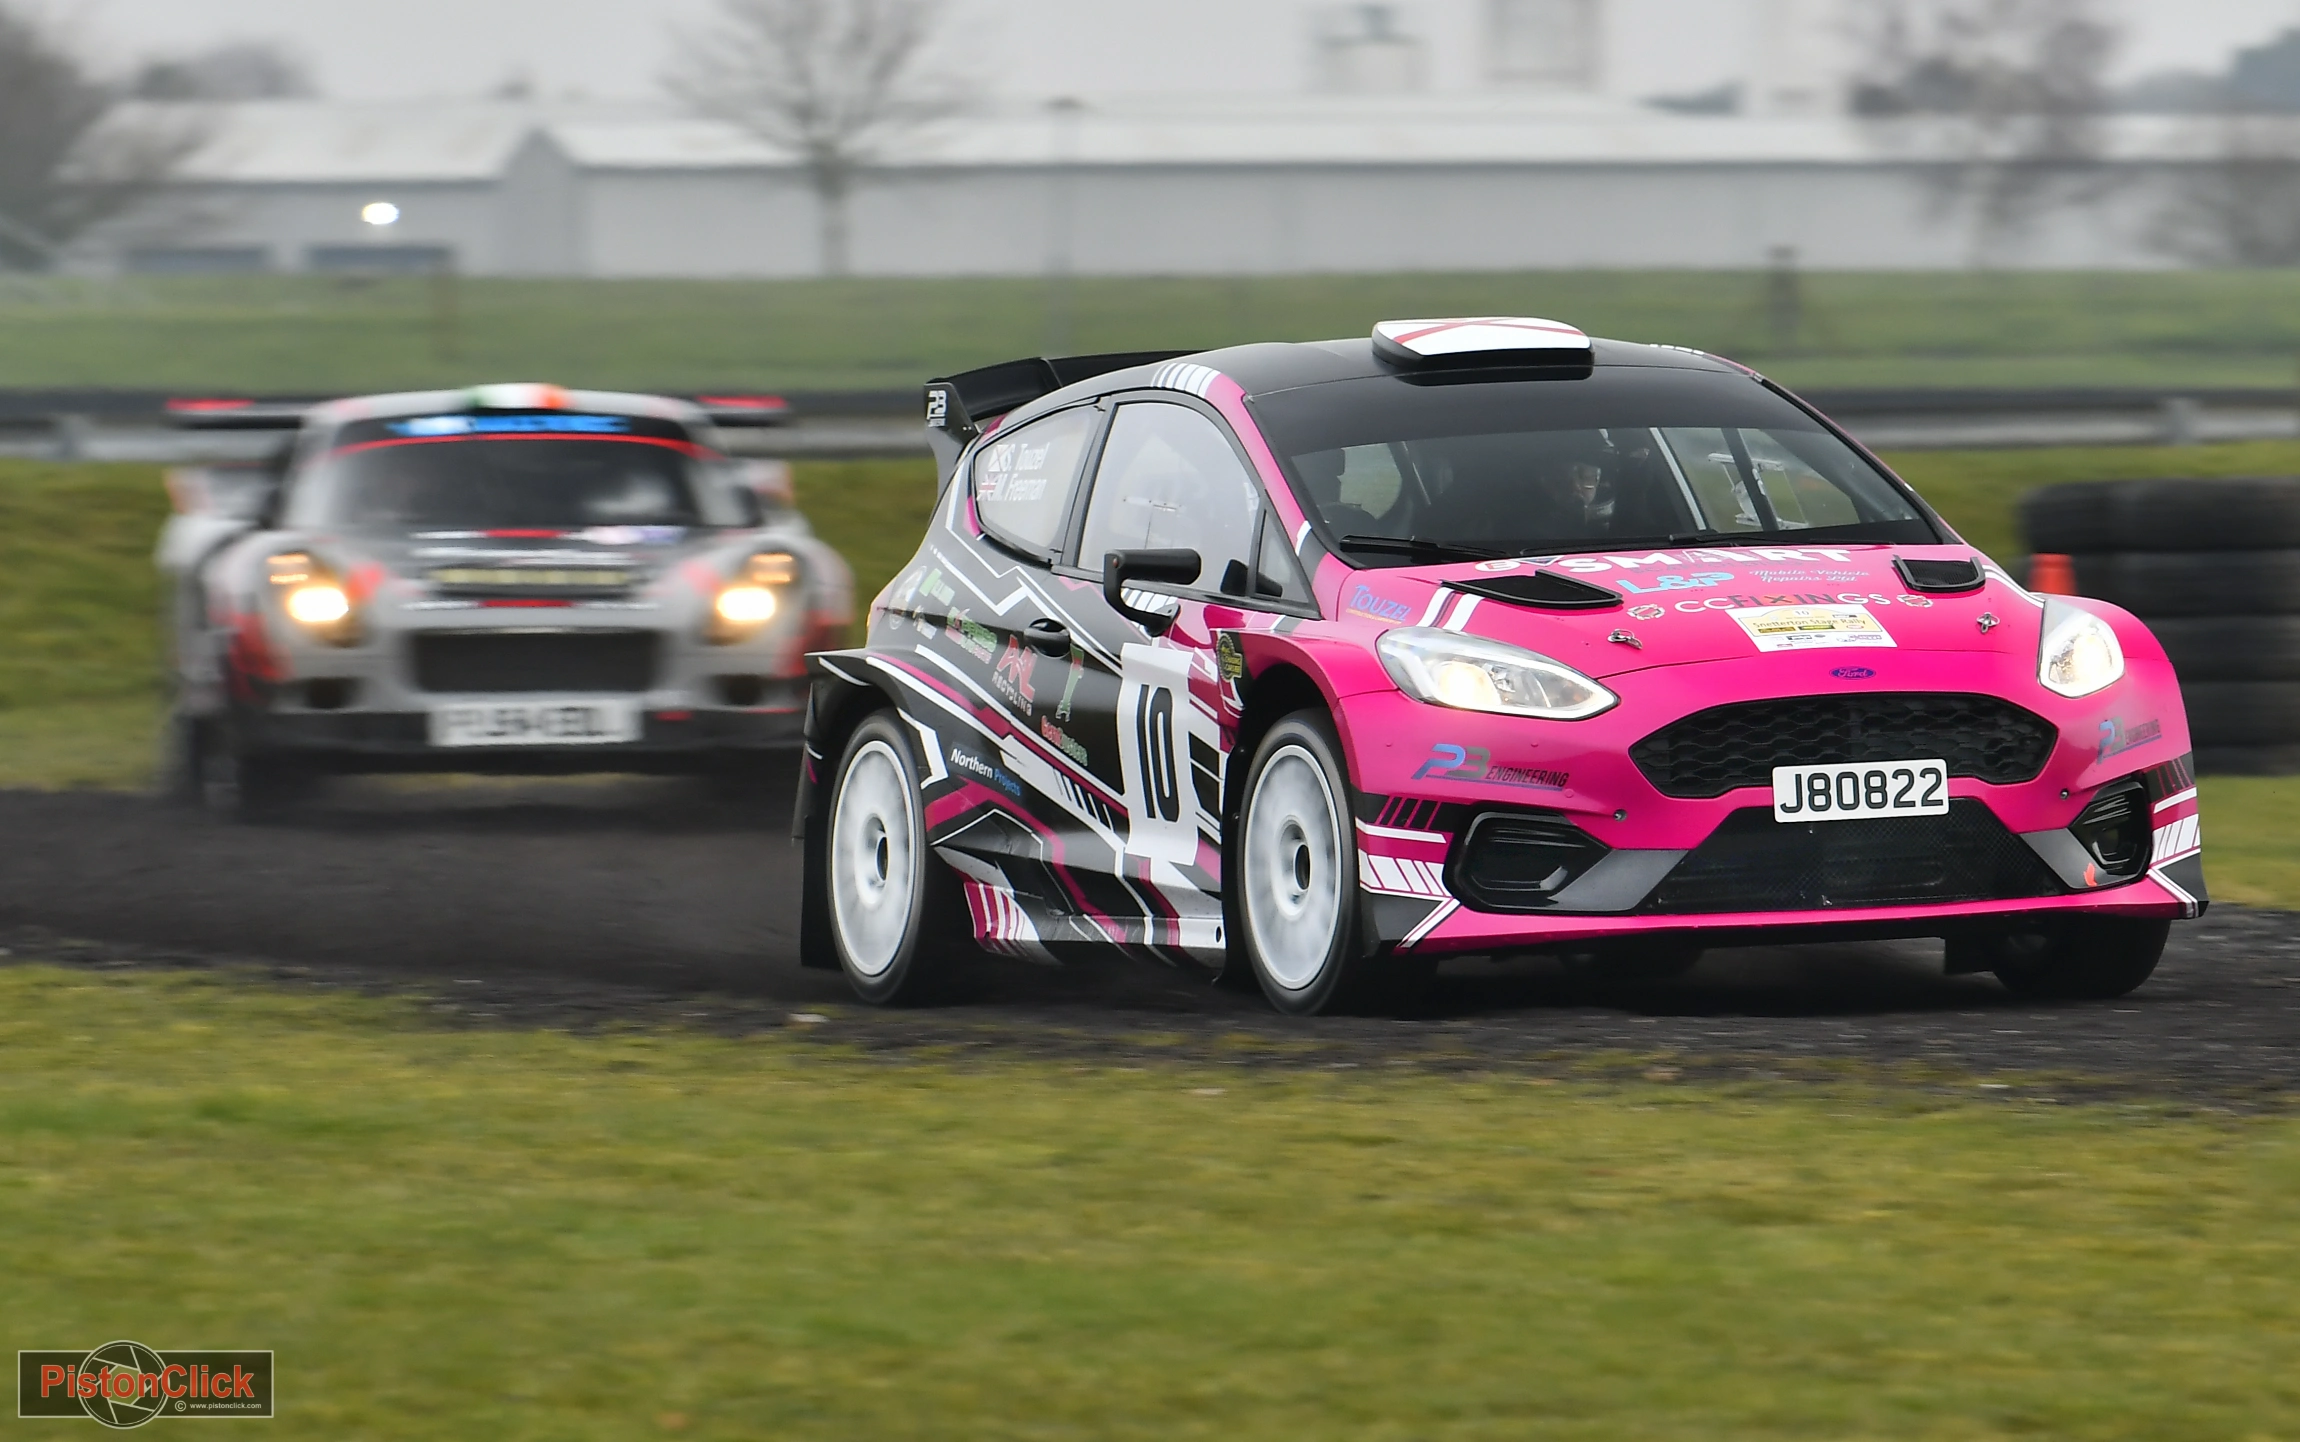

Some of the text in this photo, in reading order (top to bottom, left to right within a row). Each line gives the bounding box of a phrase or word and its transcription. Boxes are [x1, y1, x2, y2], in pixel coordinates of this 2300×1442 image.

[1615, 571, 1735, 594] L&P
[1810, 569, 1870, 577] Vehicle
[1752, 618, 1809, 628] Snetterton
[950, 748, 993, 779] Northern
[1136, 684, 1180, 823] 10
[1485, 765, 1570, 788] ENGINEERING
[1779, 767, 1944, 814] J80822
